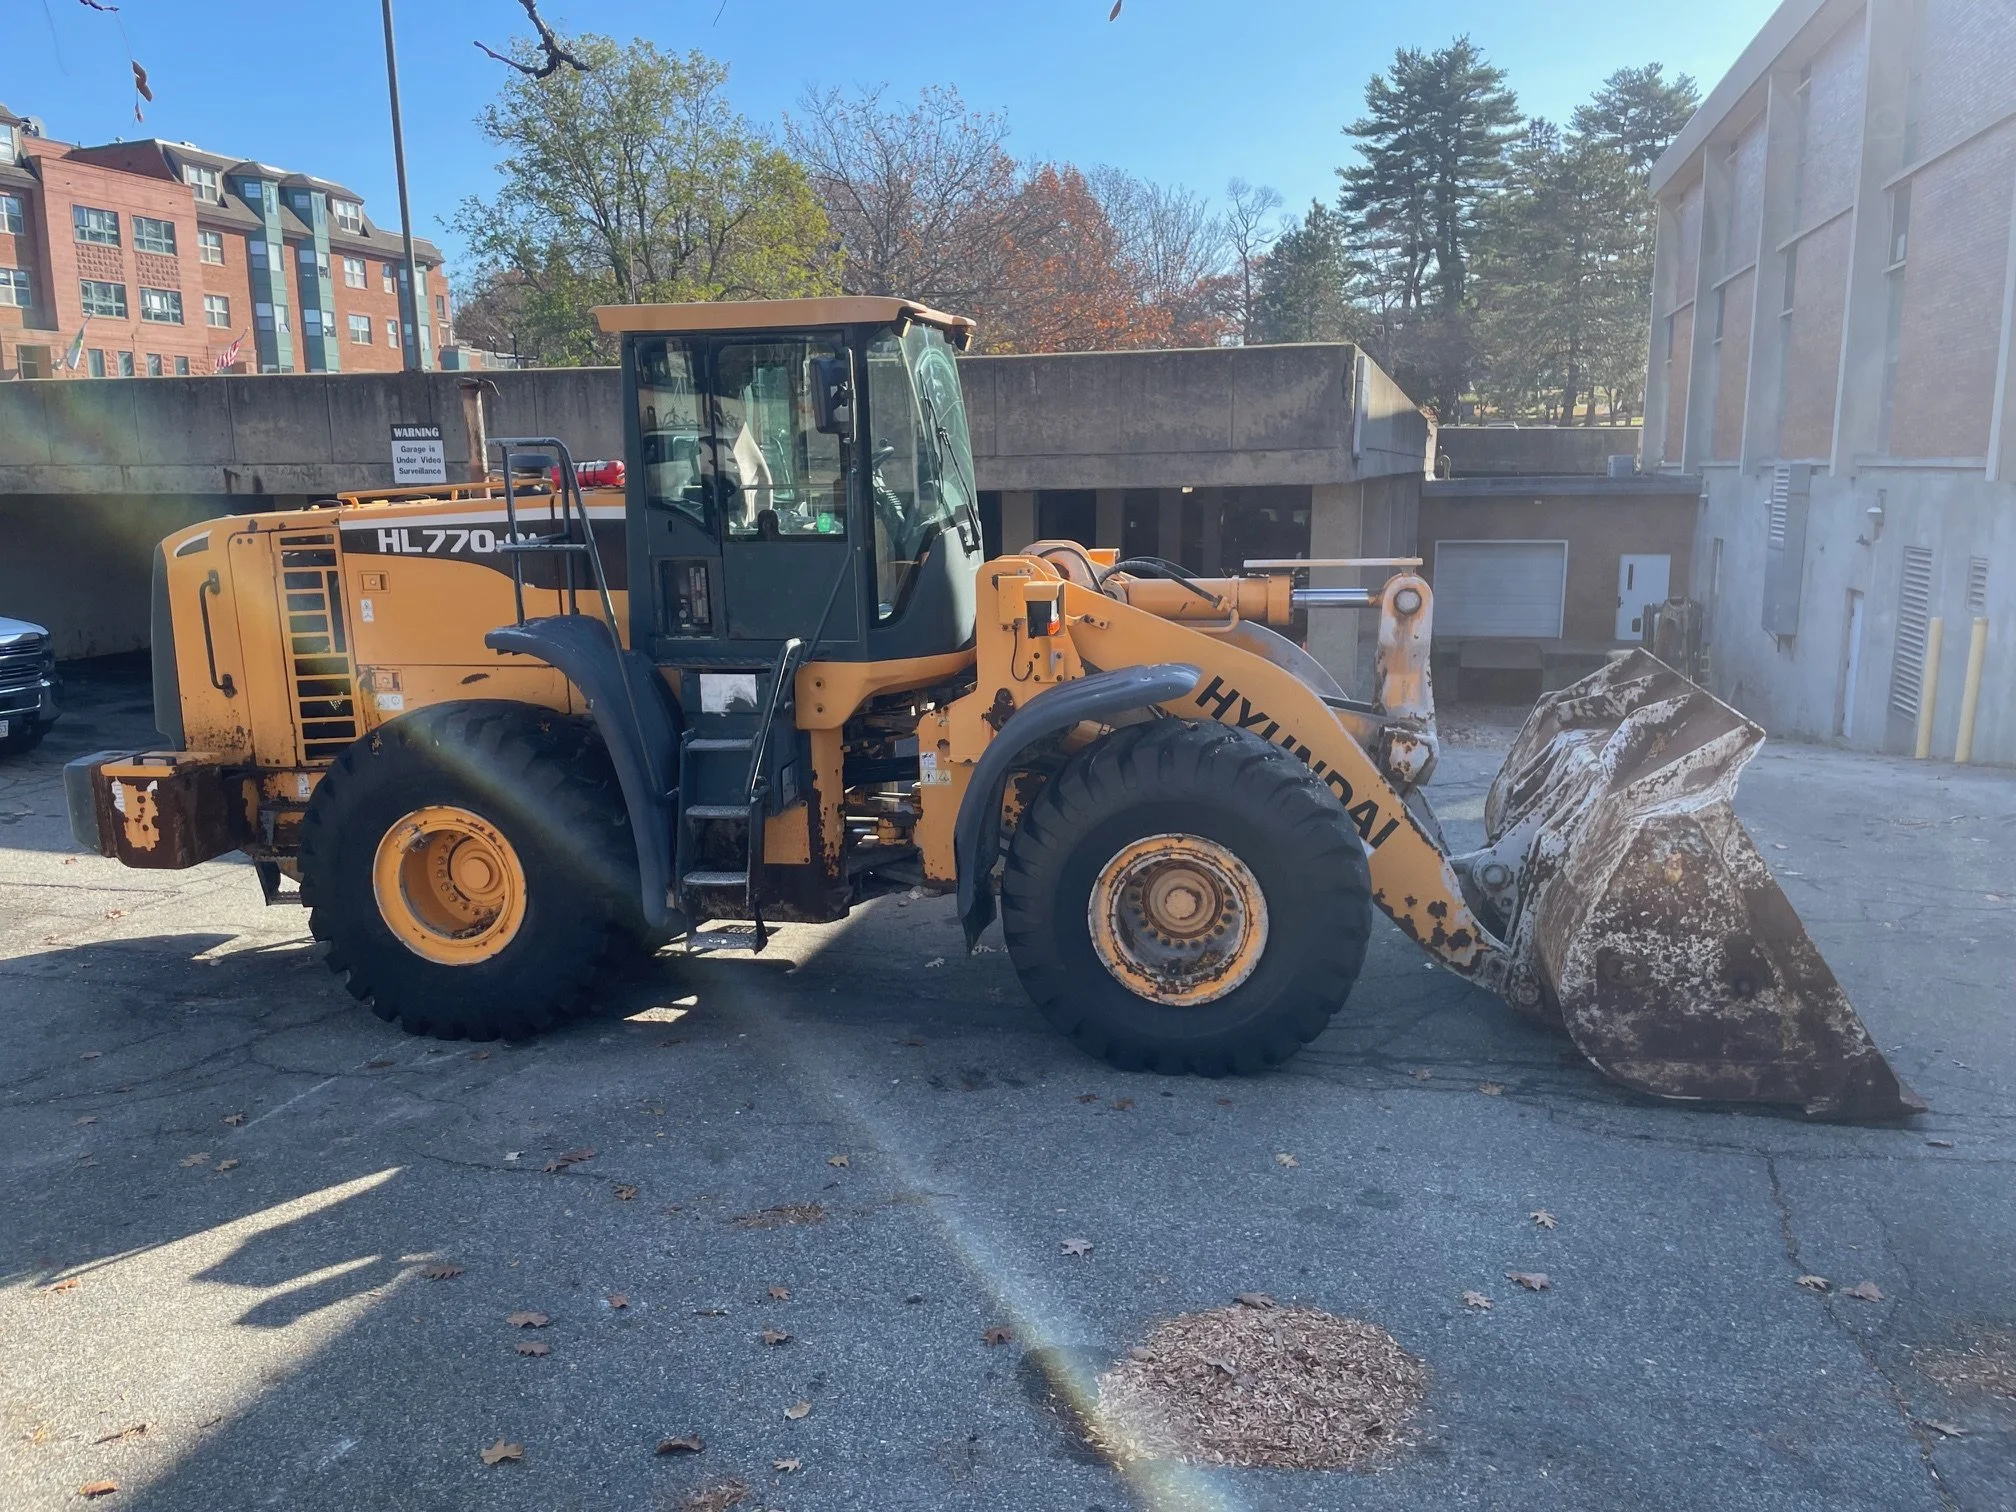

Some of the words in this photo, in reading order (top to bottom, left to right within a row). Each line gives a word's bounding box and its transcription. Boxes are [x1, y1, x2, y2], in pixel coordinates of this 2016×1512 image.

[393, 427, 439, 437] WARNING
[400, 445, 426, 454] Garage
[396, 456, 417, 464] Under
[421, 456, 441, 464] Video
[399, 467, 441, 475] Surveillance
